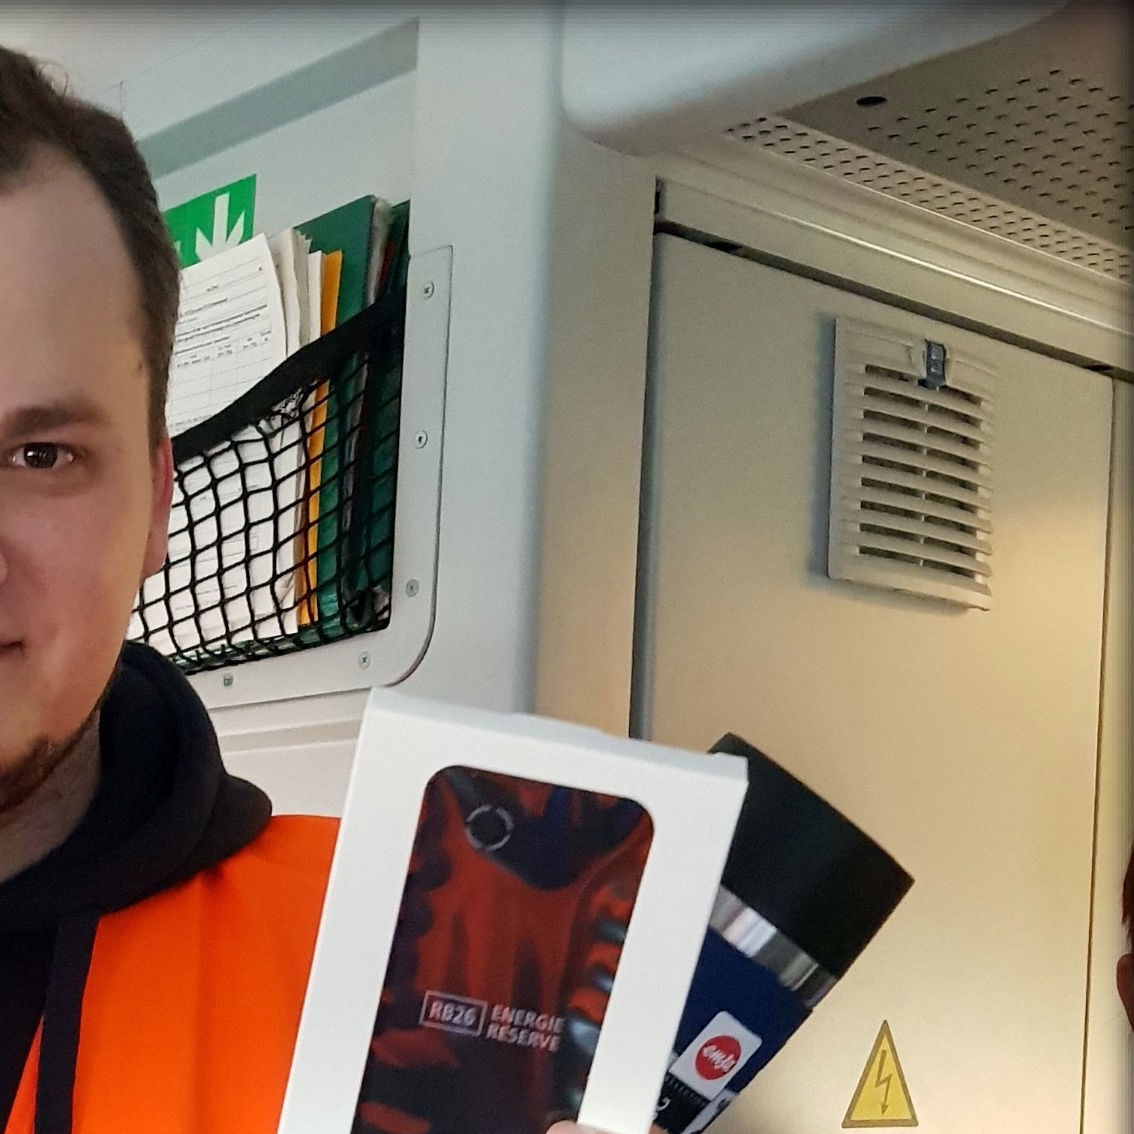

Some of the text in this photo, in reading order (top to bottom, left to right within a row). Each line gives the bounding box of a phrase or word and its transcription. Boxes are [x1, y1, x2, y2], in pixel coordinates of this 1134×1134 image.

[429, 1000, 476, 1026] RB26
[491, 1004, 565, 1034] ENERGIE
[486, 1023, 561, 1052] RESERVE
